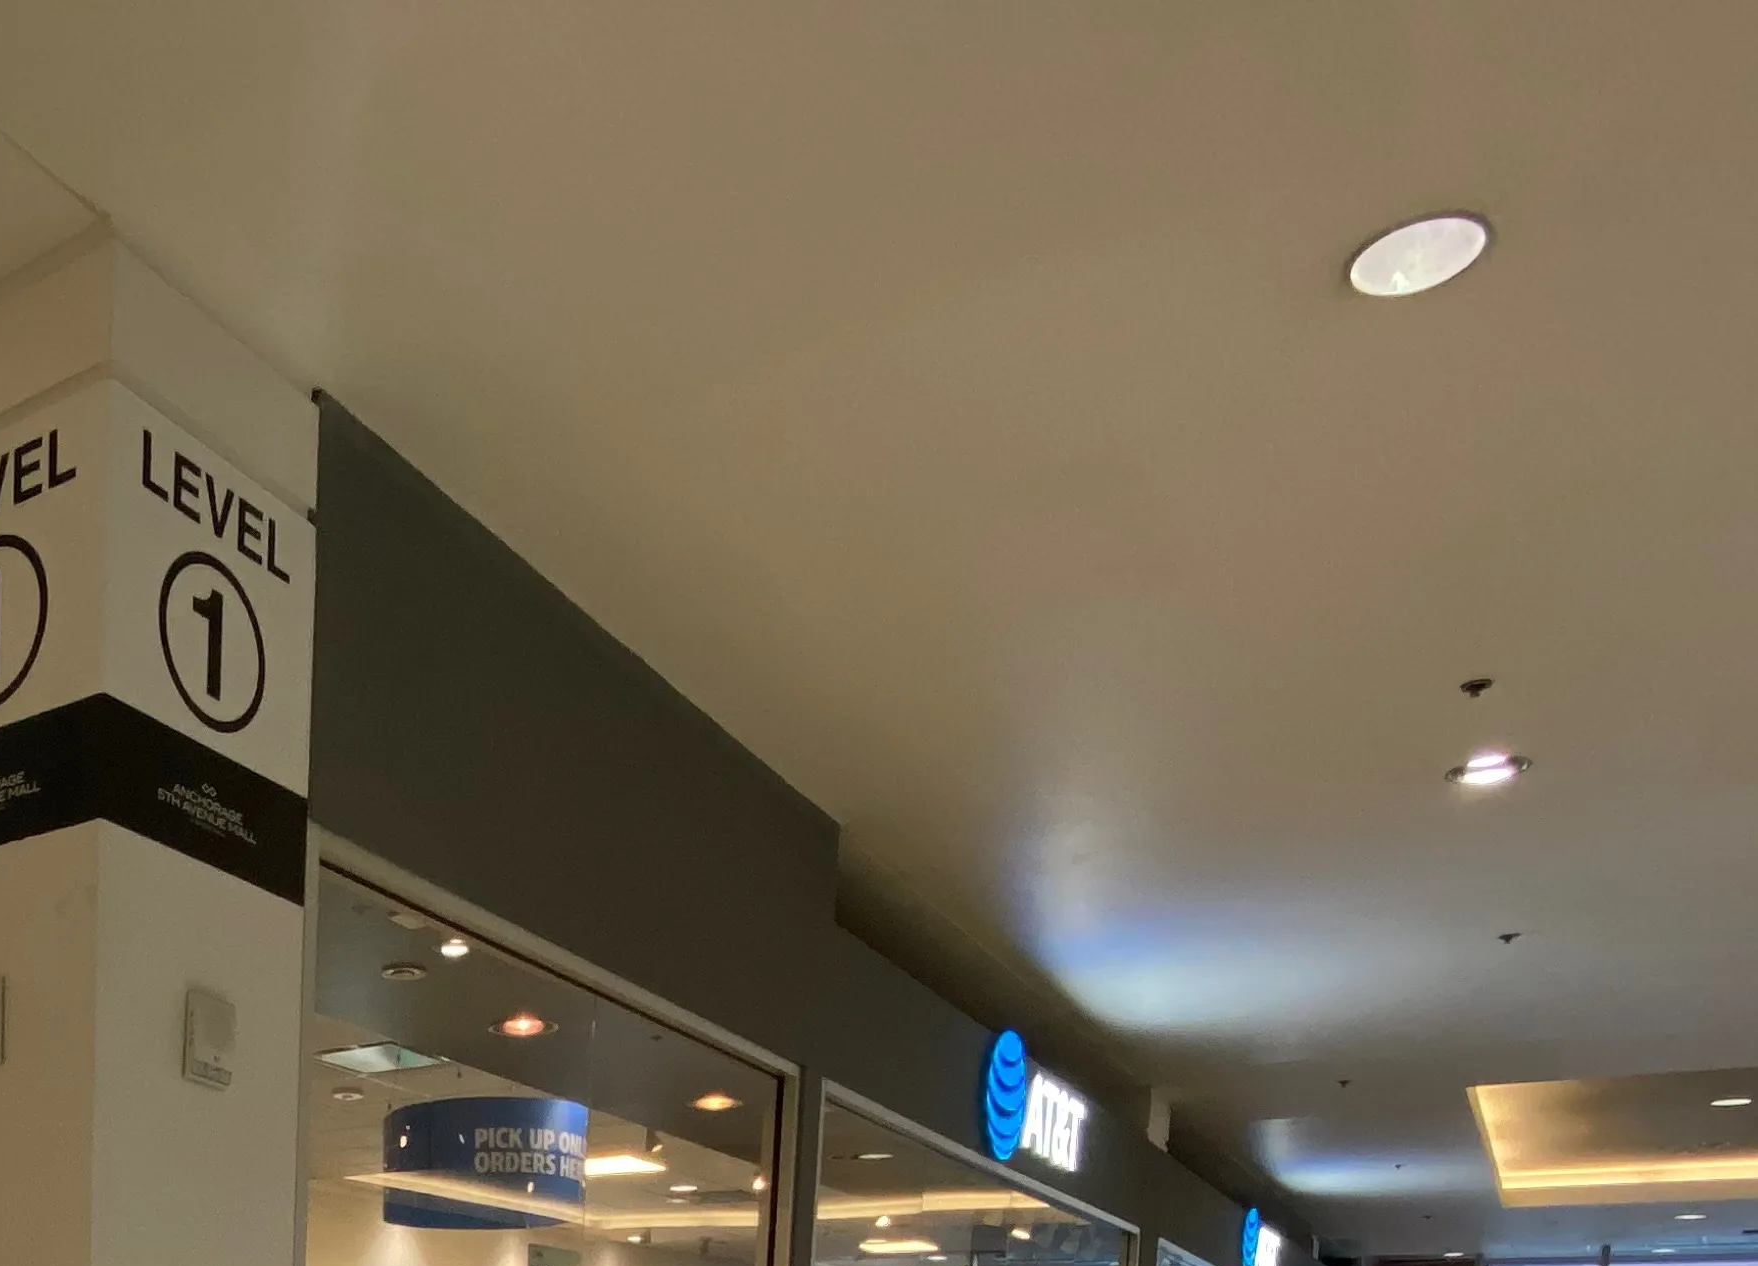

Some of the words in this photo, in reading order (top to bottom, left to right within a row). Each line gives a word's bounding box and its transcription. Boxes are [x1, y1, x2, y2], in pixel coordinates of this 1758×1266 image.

[142, 429, 290, 584] LEVEL
[193, 589, 223, 701] 1
[7, 781, 42, 800] MALL
[173, 784, 243, 826] ANCHORAGE
[182, 801, 228, 831] AVENUE
[227, 822, 257, 845] MALL
[474, 1127, 522, 1149] PICK
[529, 1128, 555, 1151] UP
[1020, 1070, 1087, 1173] AT&T
[474, 1152, 556, 1175] ORDERS
